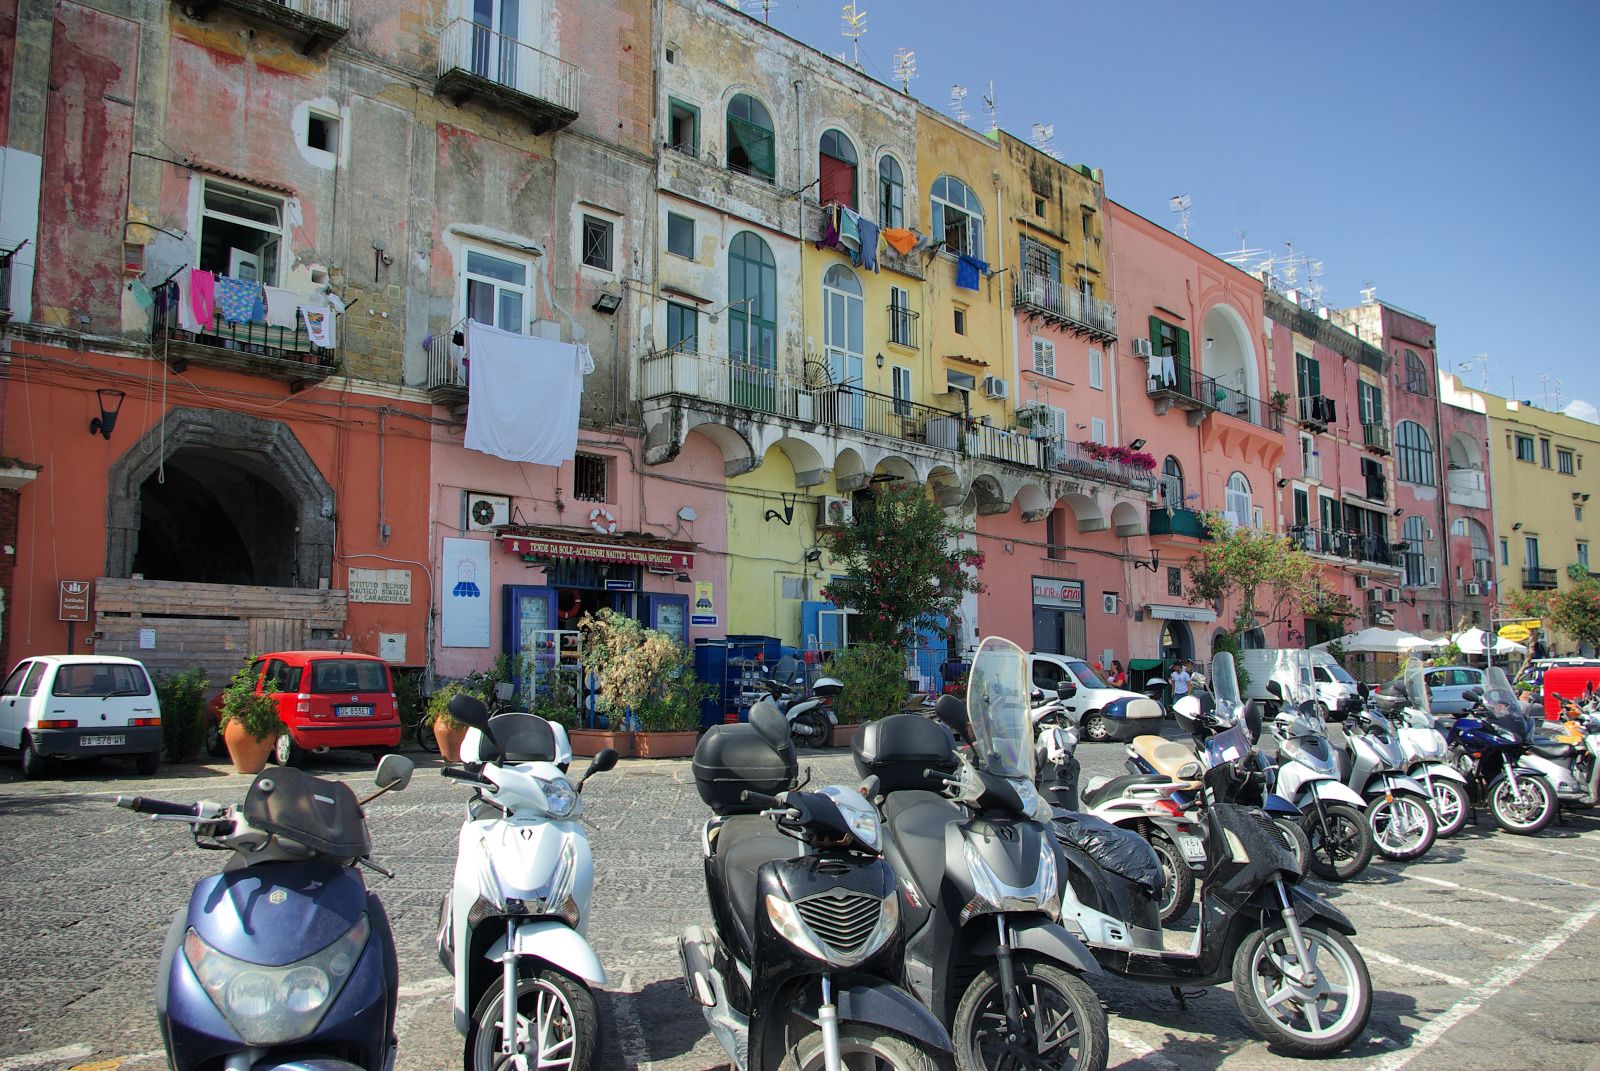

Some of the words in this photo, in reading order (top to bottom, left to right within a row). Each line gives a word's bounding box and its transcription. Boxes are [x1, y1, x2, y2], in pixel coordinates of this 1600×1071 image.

[530, 542, 549, 552] TENDE
[550, 544, 559, 554] DA
[605, 549, 627, 560] NAUTICI
[350, 581, 378, 589] ISTITUTO
[381, 582, 409, 590] TECNICO
[350, 587, 378, 595] NAUTICO
[364, 594, 404, 602] CARACCIOLO
